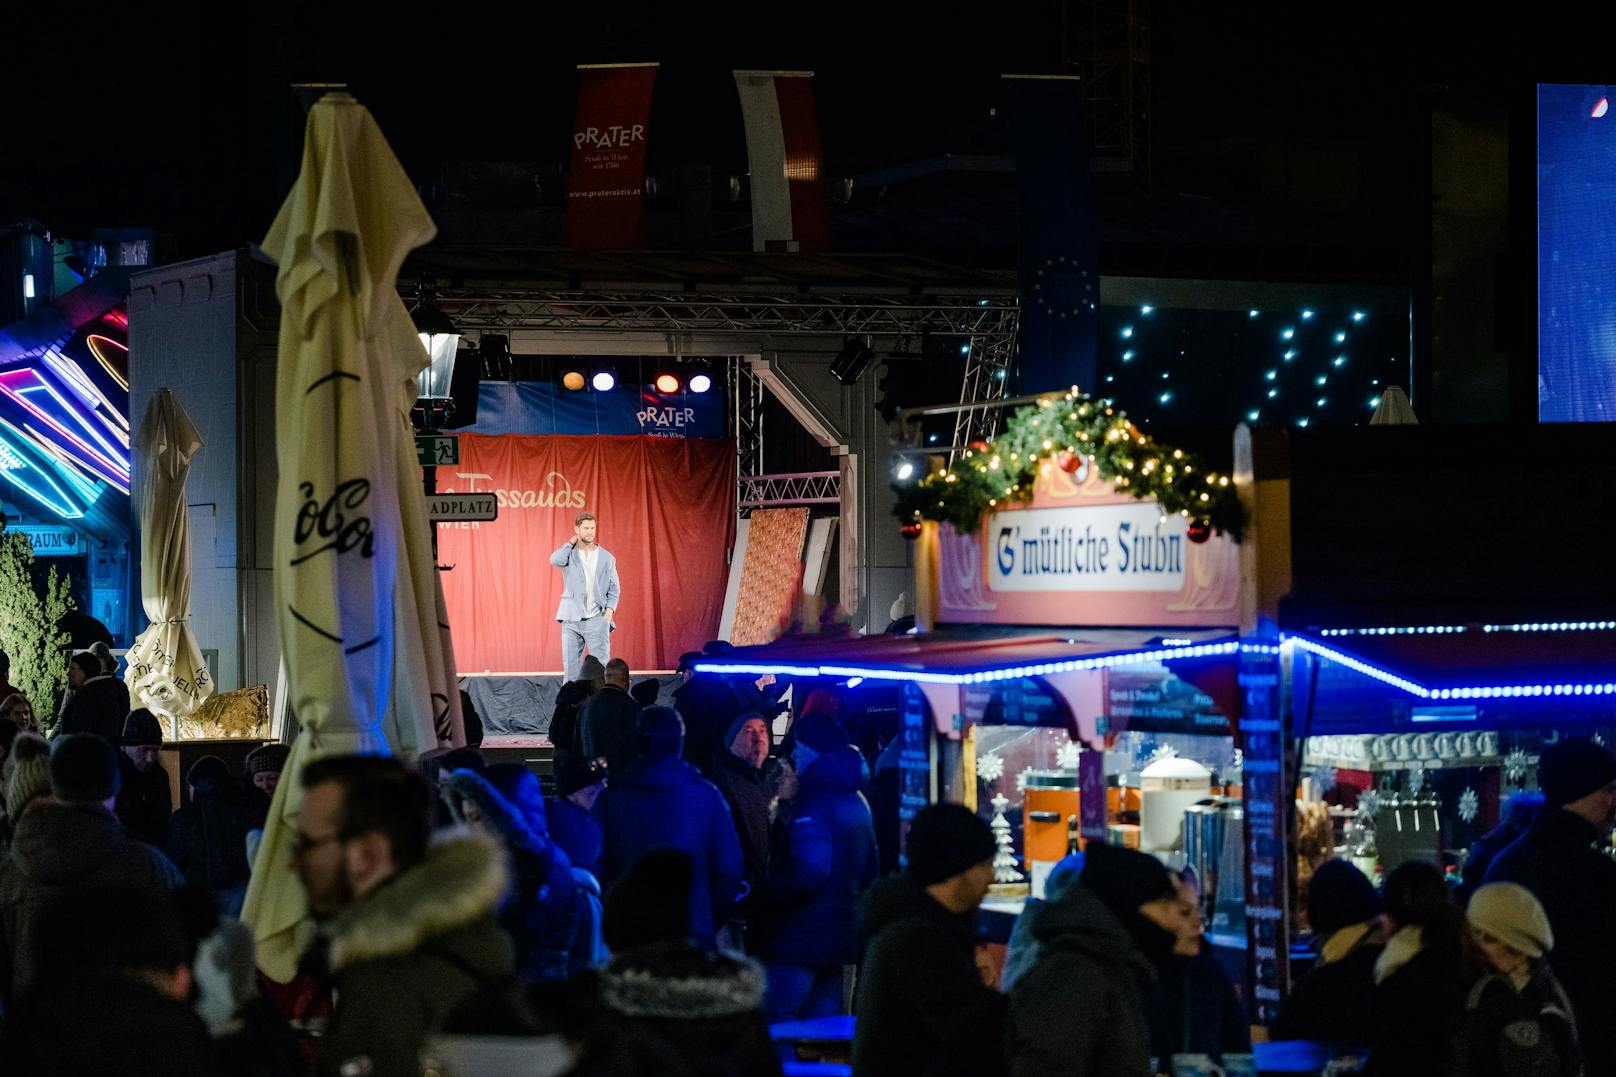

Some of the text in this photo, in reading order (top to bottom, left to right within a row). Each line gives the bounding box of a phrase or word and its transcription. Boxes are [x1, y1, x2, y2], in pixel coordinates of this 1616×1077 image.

[574, 124, 644, 150] PRATER
[568, 188, 641, 198] www.prateraktiv.at
[636, 406, 696, 427] PRATER
[456, 471, 586, 509] Tssauds
[430, 501, 493, 514] ADPLATZ
[439, 521, 480, 530] WIEN
[29, 533, 62, 548] RAUM
[997, 521, 1183, 577] G'mütliche Stubn
